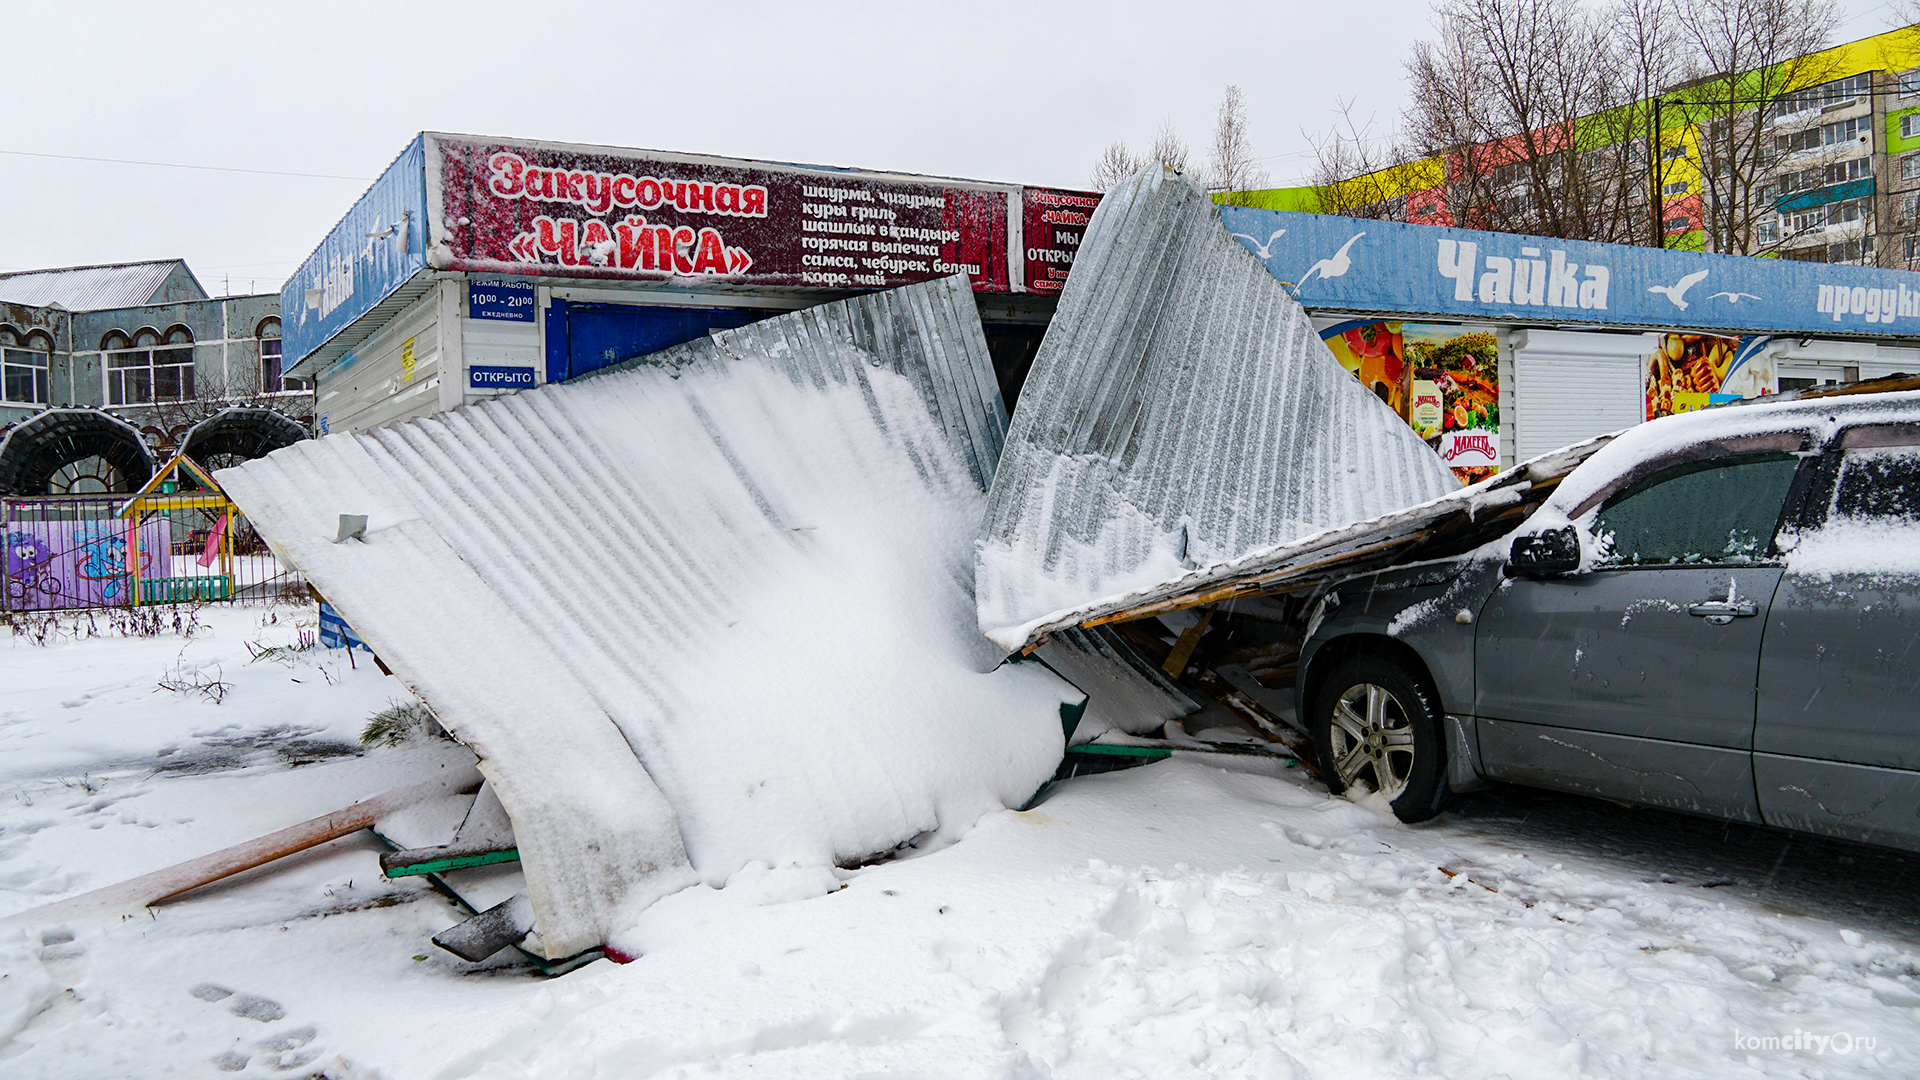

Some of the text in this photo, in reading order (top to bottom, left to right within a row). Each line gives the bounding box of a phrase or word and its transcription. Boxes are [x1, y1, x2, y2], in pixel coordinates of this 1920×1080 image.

[489, 152, 768, 218] Закусочная
[802, 185, 945, 209] шаурма, чизурма
[1032, 190, 1099, 208] Закусочная
[802, 203, 897, 221] куры гриль
[802, 220, 876, 235] шашлык
[880, 225, 888, 236] в
[508, 214, 753, 276] «ЧАЙКА»
[1056, 231, 1079, 245] МЫ
[802, 237, 939, 256] горячая выпечка
[802, 254, 858, 269] самса,
[862, 255, 930, 273] чебурек,
[1027, 248, 1076, 263] ОТКРЫ
[802, 270, 886, 286] кофе, чай
[1056, 270, 1070, 279] на
[1437, 239, 1610, 310] Чайка
[501, 281, 533, 290] РАБОТЫ
[1033, 280, 1063, 289] самое
[482, 310, 523, 319] ЕЖЕДНЕВНО
[473, 372, 531, 383] ОТКРЫТО
